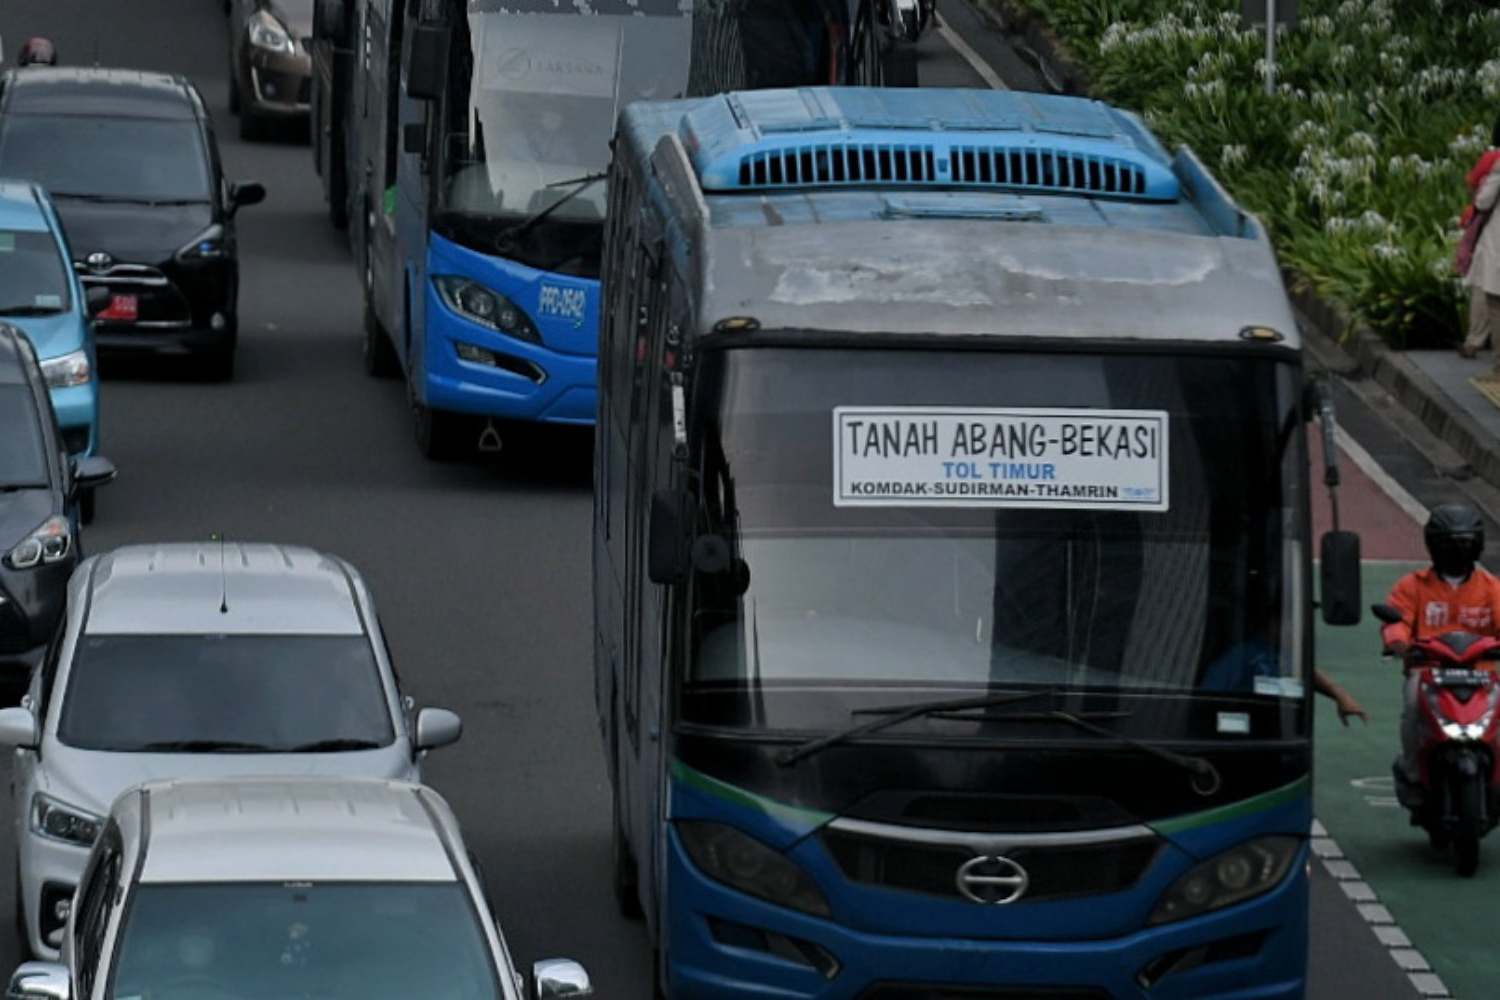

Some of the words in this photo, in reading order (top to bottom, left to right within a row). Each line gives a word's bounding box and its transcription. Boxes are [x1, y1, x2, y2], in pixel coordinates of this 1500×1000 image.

[846, 420, 938, 458] TANAH
[951, 421, 1157, 460] ABANG-BEKASI
[942, 461, 982, 479] TOL
[988, 462, 1055, 480] TIMUR
[851, 481, 1118, 498] KOMDAK-SUDIRMAN-THAMRIN
